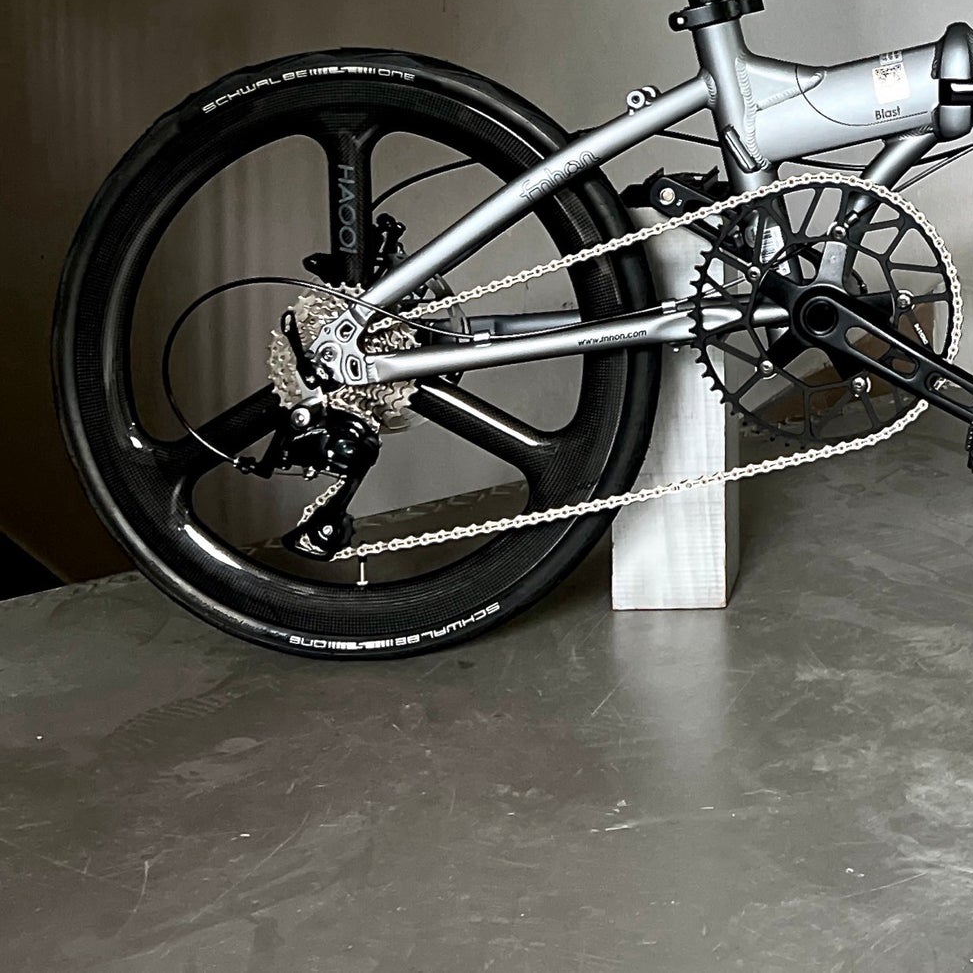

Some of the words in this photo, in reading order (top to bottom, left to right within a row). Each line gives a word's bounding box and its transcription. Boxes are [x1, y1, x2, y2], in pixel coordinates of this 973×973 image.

[202, 69, 308, 114] SCHWALBE
[875, 105, 901, 120] Blast
[519, 150, 600, 202] fnhon
